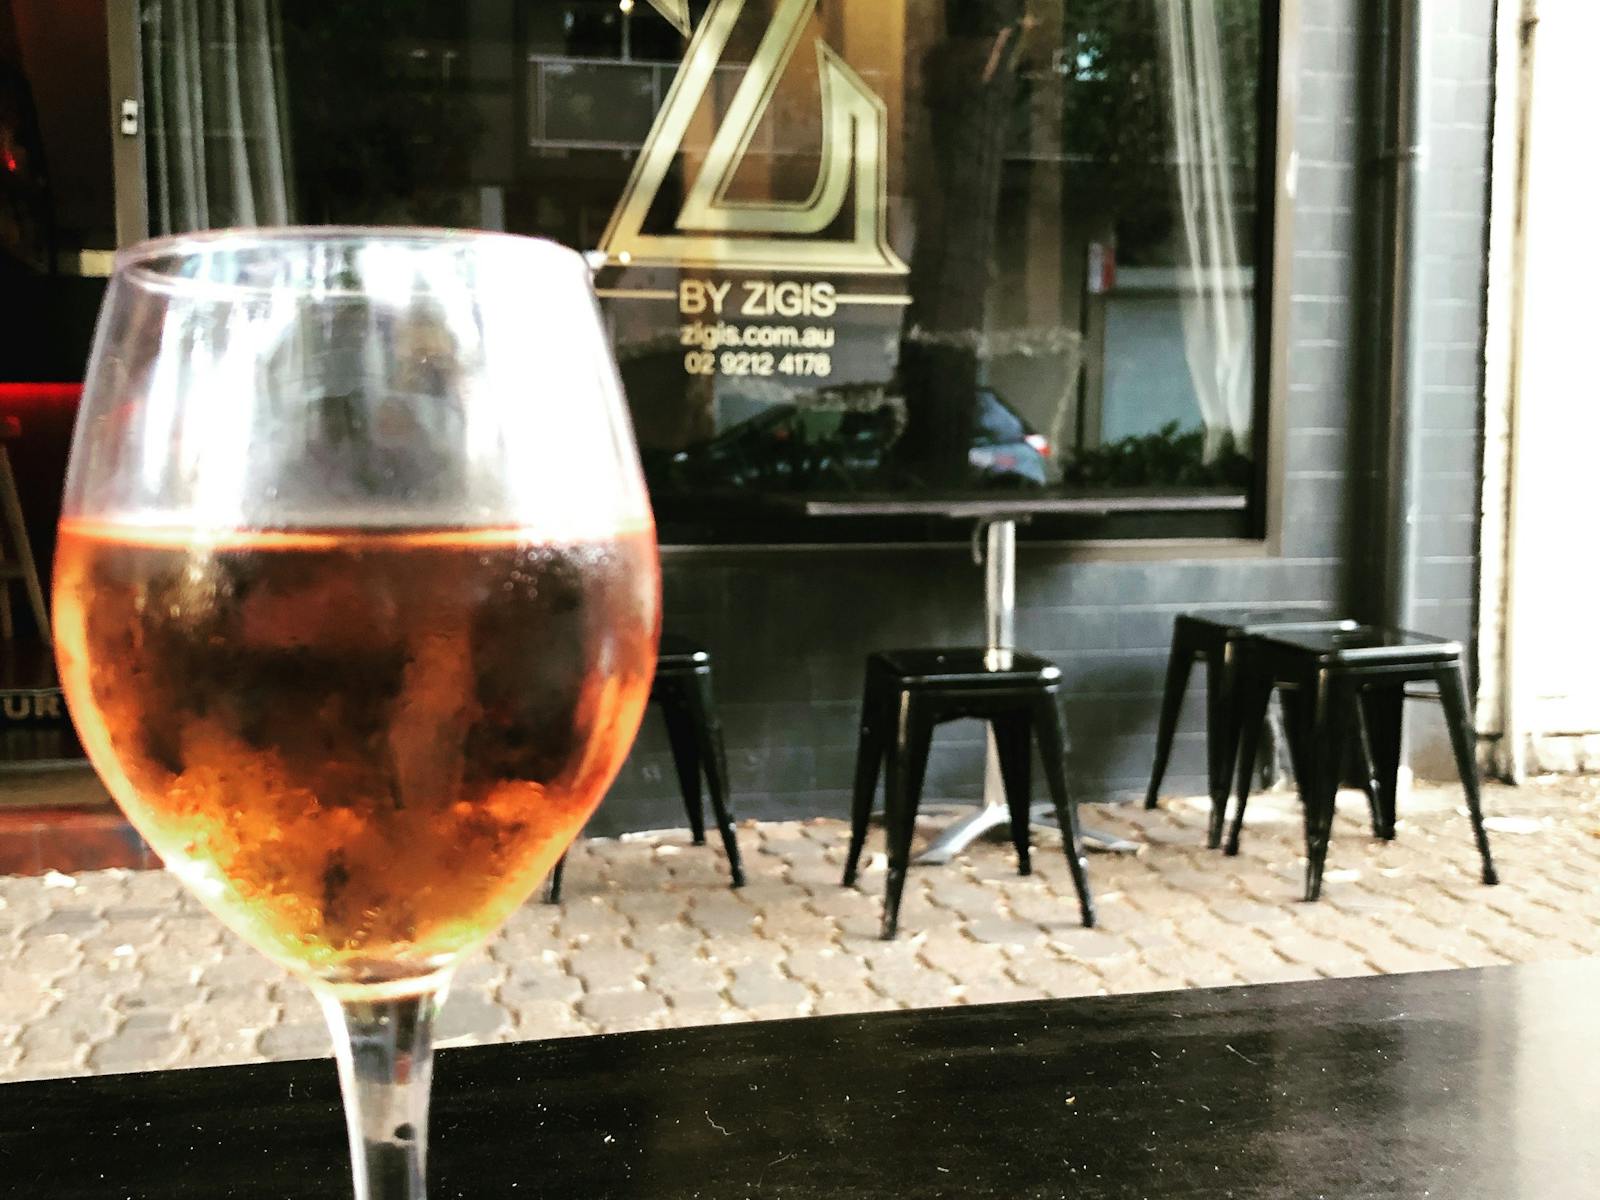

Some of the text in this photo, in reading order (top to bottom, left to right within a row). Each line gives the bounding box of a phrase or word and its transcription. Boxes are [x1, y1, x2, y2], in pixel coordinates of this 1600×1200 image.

[679, 279, 837, 317] BY ZIGIS
[680, 321, 836, 350] zigis.com.au
[684, 350, 716, 375] 02
[720, 350, 775, 377] 9212
